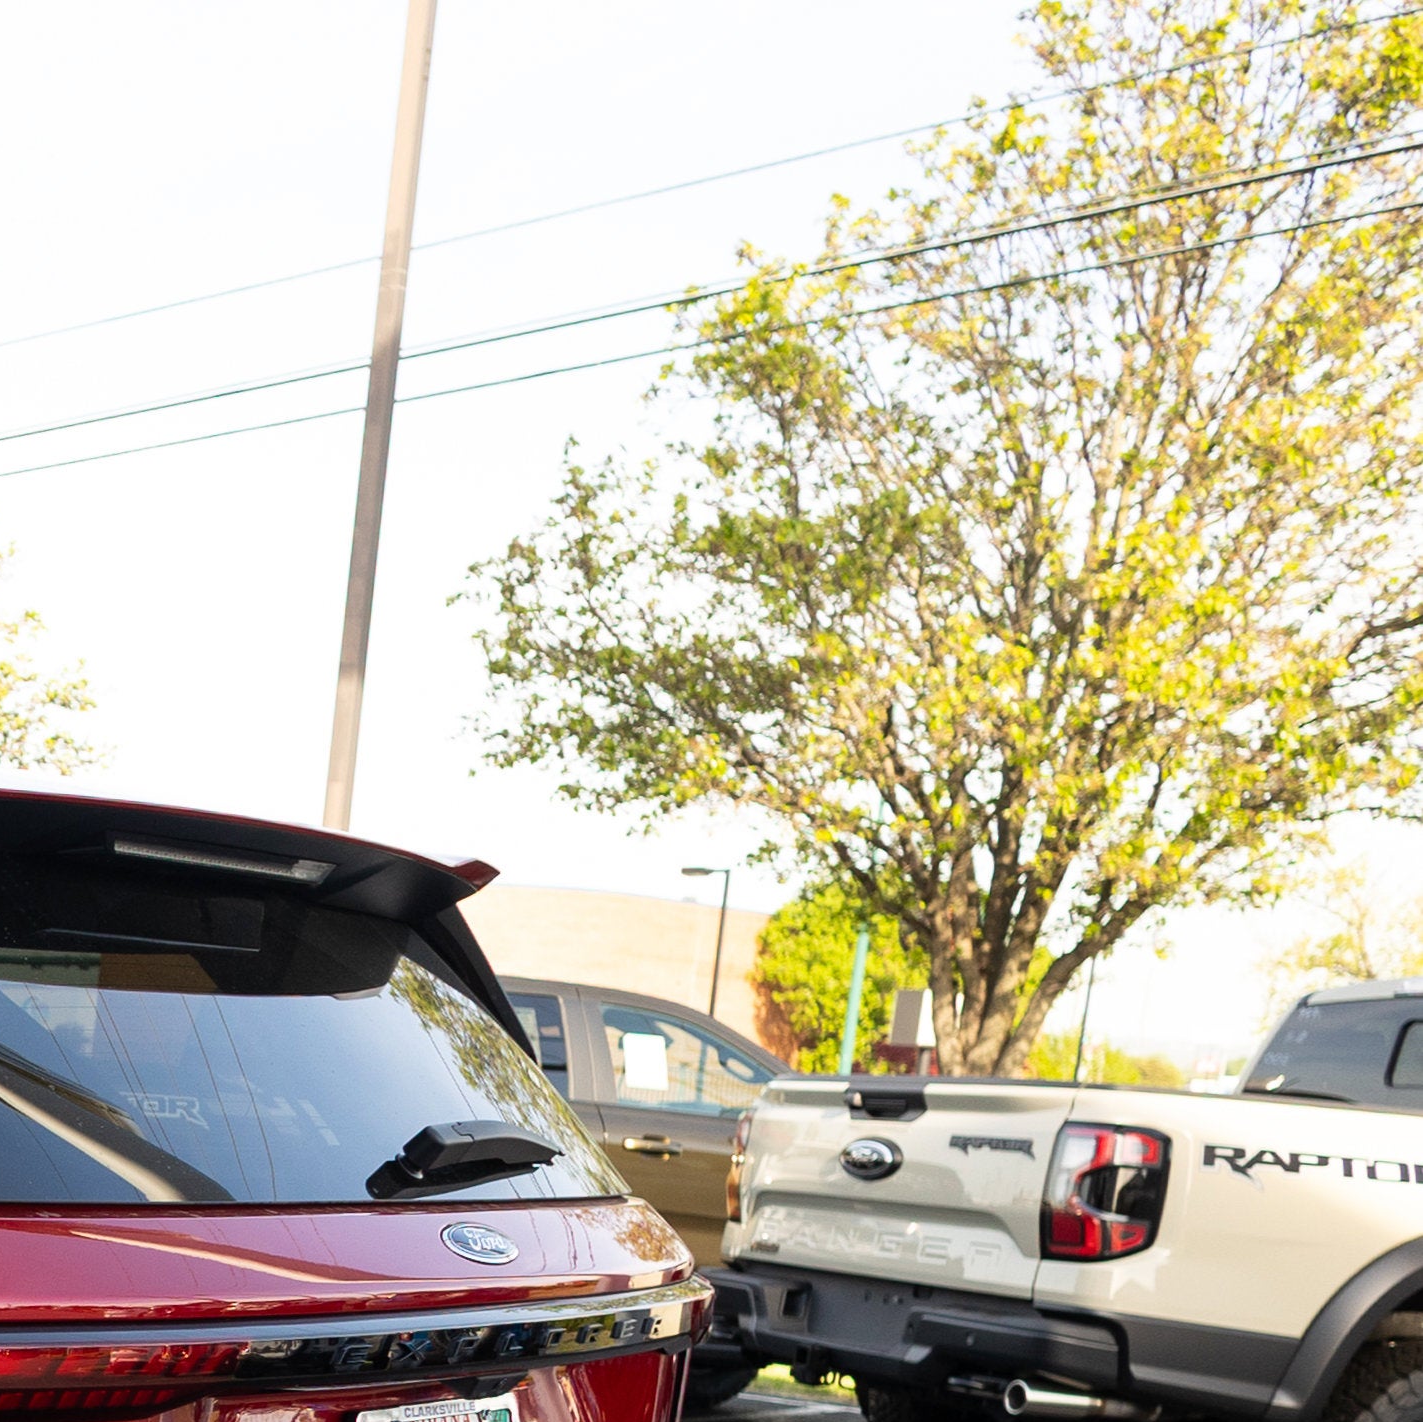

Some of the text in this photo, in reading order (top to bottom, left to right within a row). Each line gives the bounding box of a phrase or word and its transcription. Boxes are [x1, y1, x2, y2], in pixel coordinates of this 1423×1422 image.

[1203, 1144, 1423, 1188] RAPTO
[463, 1228, 509, 1251] Ford
[753, 1219, 1002, 1268] RANGER
[333, 1316, 664, 1371] EXPLORER
[404, 1401, 476, 1419] CLARKSVILLE
